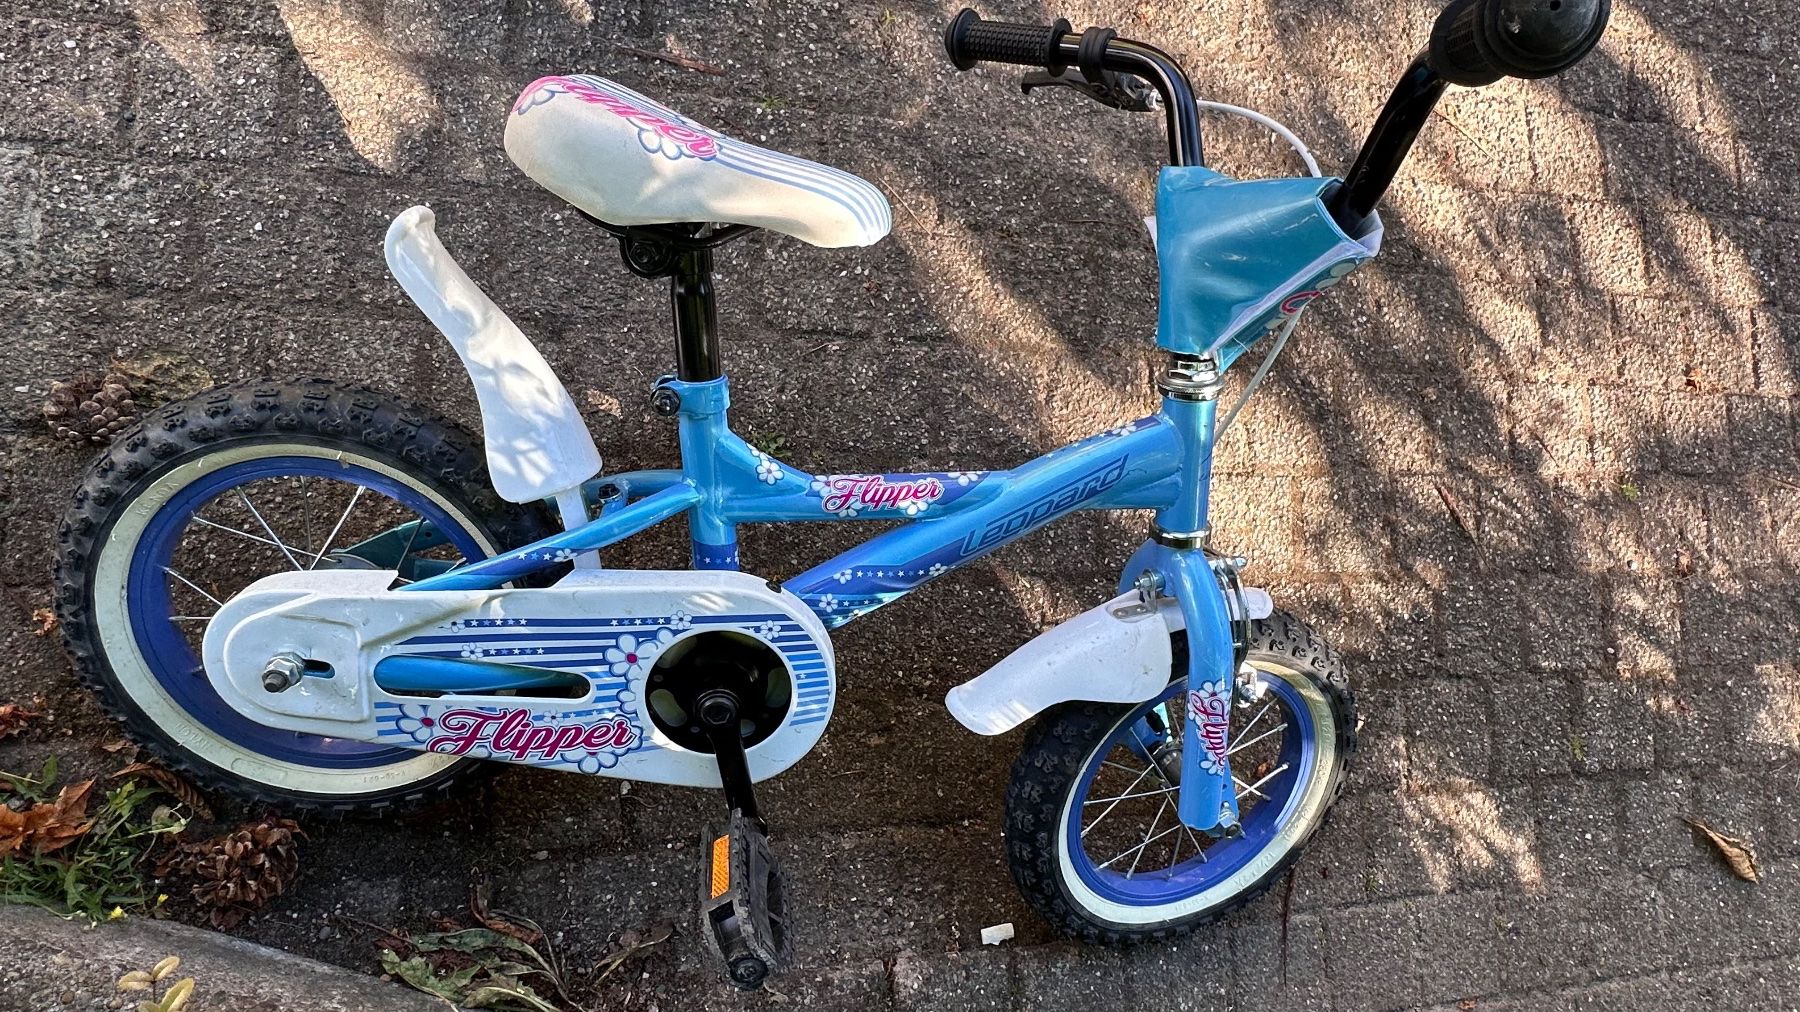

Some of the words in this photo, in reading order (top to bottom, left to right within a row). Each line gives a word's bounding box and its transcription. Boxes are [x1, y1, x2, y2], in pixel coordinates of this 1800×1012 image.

[824, 475, 944, 512] Flipper
[959, 453, 1130, 557] Leopard
[427, 708, 637, 761] Flipper
